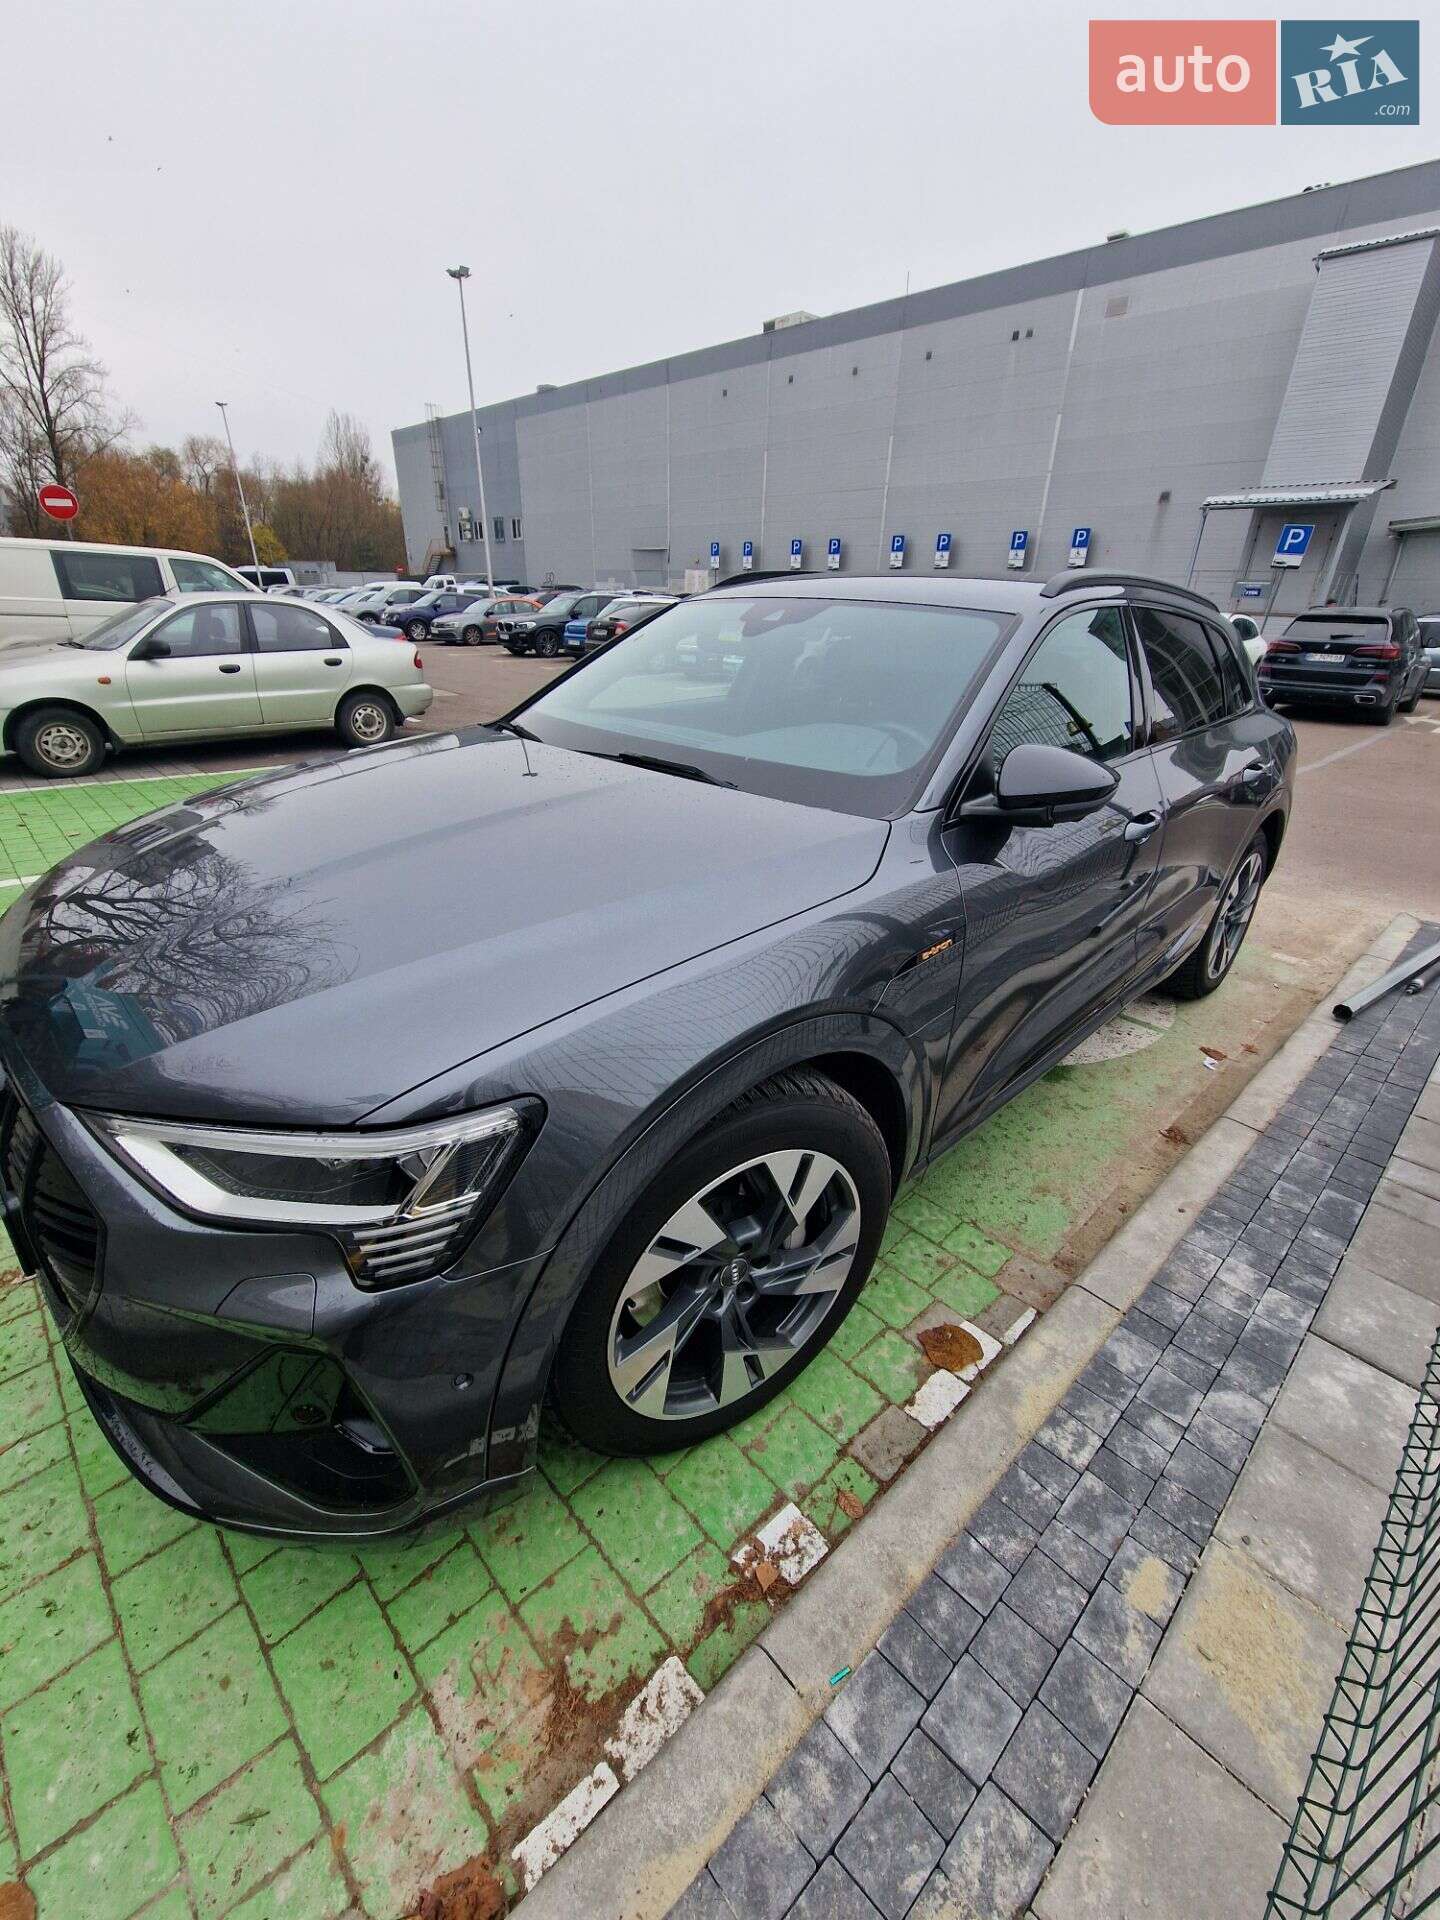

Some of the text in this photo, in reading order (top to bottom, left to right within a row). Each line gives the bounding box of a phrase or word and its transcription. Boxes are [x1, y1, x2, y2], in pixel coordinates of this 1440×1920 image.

[893, 537, 902, 550] P
[939, 535, 948, 550] P
[1014, 533, 1025, 547] P
[1075, 530, 1087, 545] P
[1284, 528, 1305, 550] P
[793, 541, 800, 553] P
[830, 540, 839, 553] P
